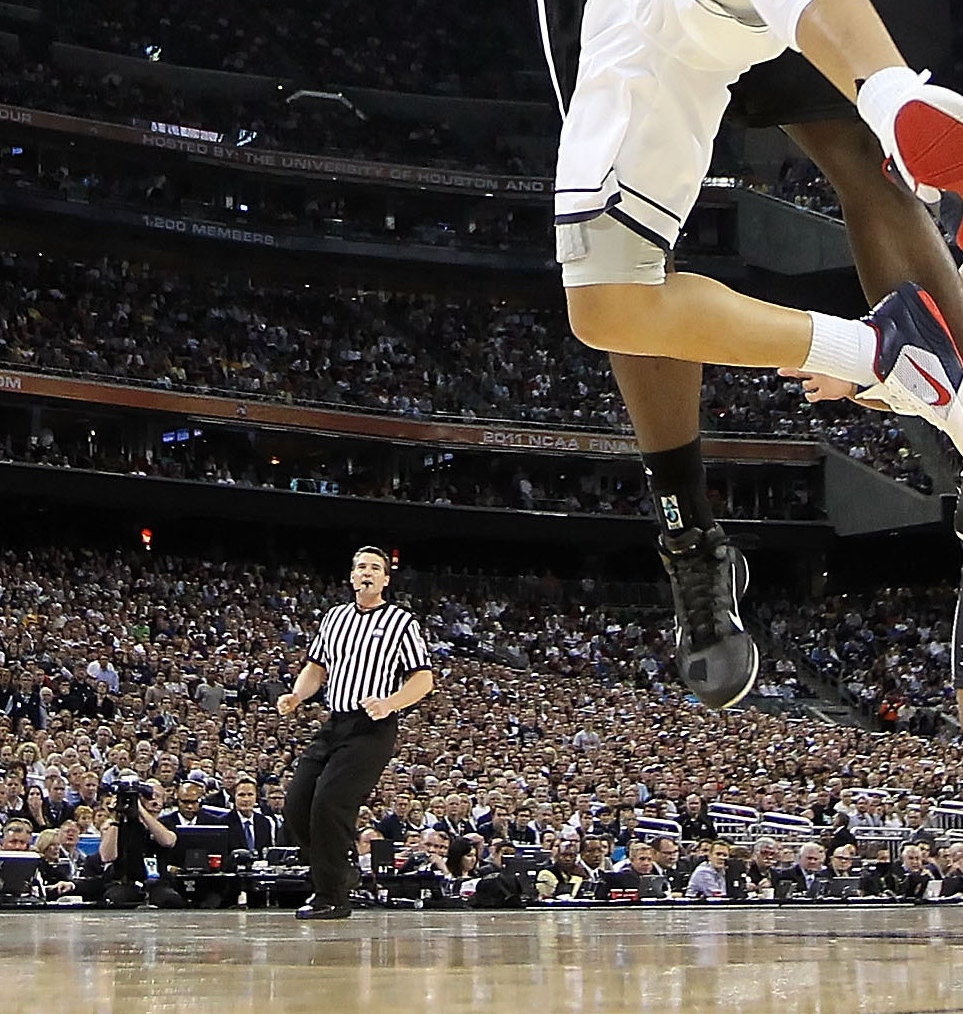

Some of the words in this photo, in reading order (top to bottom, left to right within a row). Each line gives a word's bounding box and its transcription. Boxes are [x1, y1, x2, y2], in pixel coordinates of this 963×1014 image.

[142, 134, 208, 154] HOSTED
[214, 145, 239, 160] BY:
[246, 152, 276, 166] THE
[281, 157, 383, 177] UNIVERSITY
[390, 168, 411, 181] OF
[418, 172, 498, 190] HOUSTON
[505, 180, 545, 192] AND
[483, 431, 522, 445] 2011
[528, 435, 580, 450] NCAA
